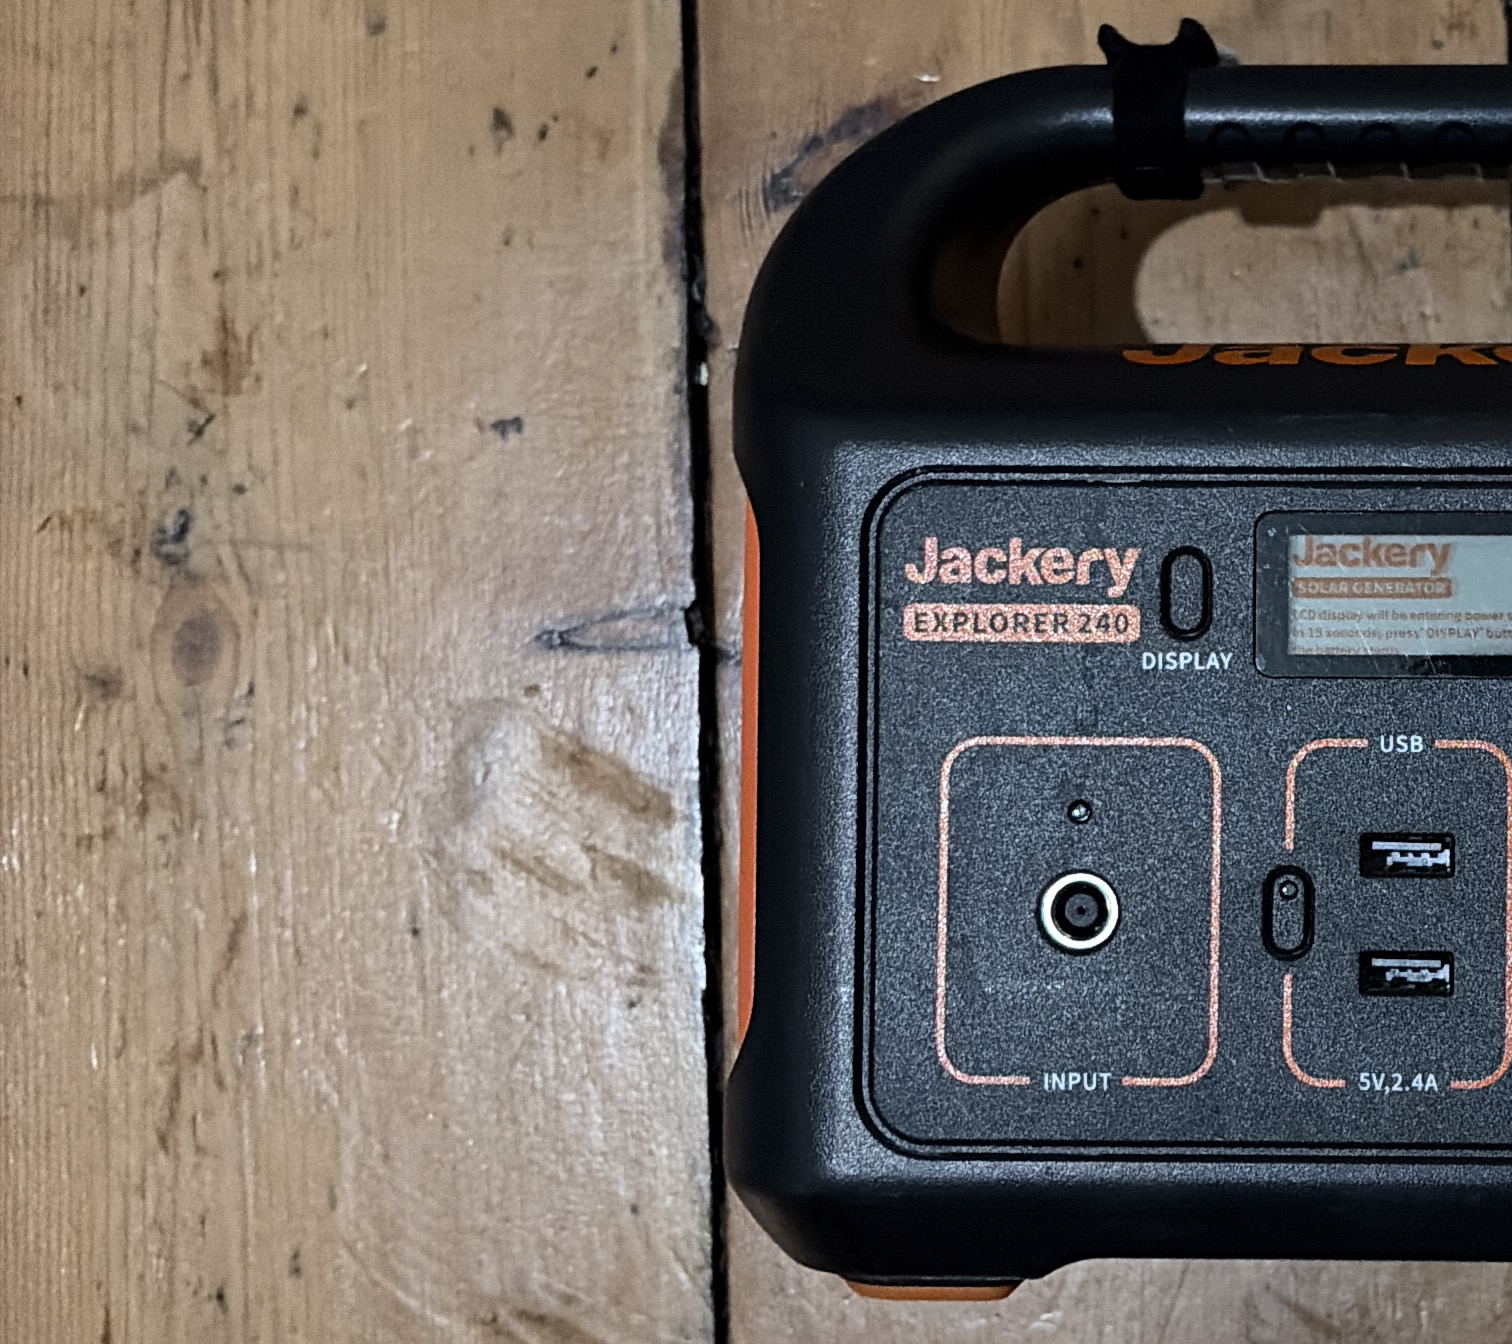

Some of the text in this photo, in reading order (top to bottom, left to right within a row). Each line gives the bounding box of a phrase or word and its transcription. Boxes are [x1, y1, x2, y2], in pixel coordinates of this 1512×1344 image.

[1292, 534, 1453, 577] Jackery
[904, 536, 1141, 597] Jackery
[1299, 581, 1446, 595] SOLAR GENERATOR
[914, 611, 1131, 635] EXPLORER 240
[1141, 652, 1233, 671] DISPLAY
[1379, 734, 1424, 754] USB
[1043, 1072, 1111, 1092] INPUT
[1358, 1072, 1439, 1095] 5V,2.4A
